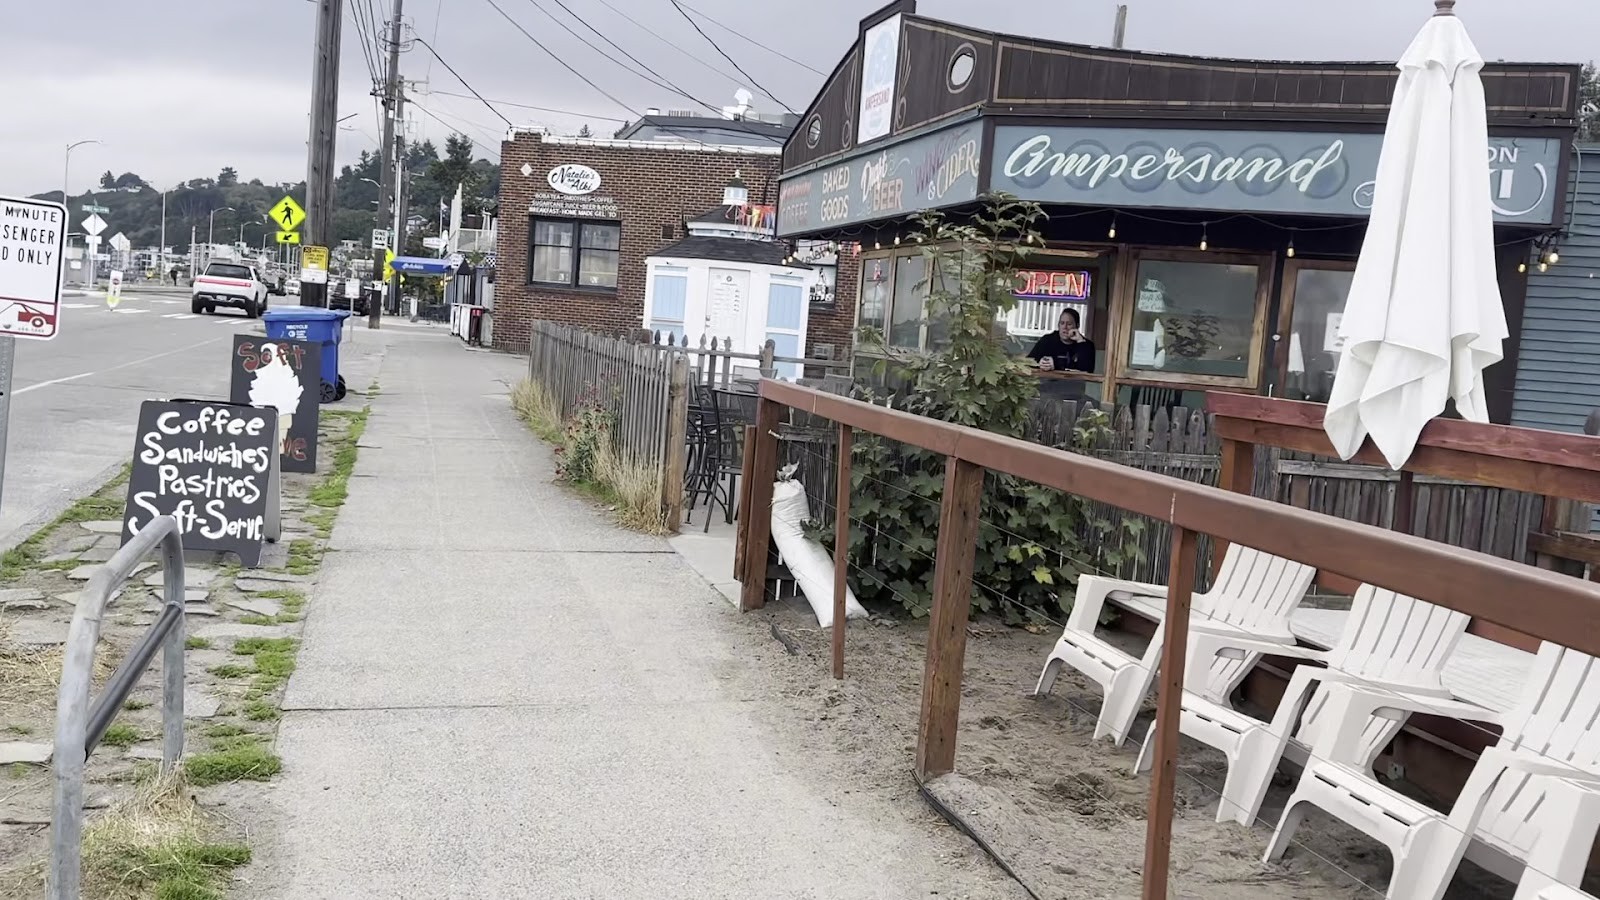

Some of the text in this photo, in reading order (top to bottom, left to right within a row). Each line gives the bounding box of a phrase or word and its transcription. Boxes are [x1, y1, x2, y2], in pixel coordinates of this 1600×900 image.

[552, 166, 595, 184] Natalie's
[937, 140, 980, 199] CIDER
[1004, 134, 1343, 192] Ampersand
[571, 180, 593, 191] Alki
[822, 166, 849, 194] BAKED
[820, 194, 850, 222] GOODS
[872, 178, 904, 211] BEER
[5, 206, 58, 223] MINUTE
[0, 224, 55, 245] SENGER
[18, 248, 52, 266] ONLY
[1015, 271, 1085, 297] OPEN
[238, 342, 306, 373] Soft
[157, 407, 265, 435] Coffee
[140, 432, 268, 473] Sandwiches
[158, 464, 261, 504] Pastries
[128, 492, 264, 540] Sft-Serve
